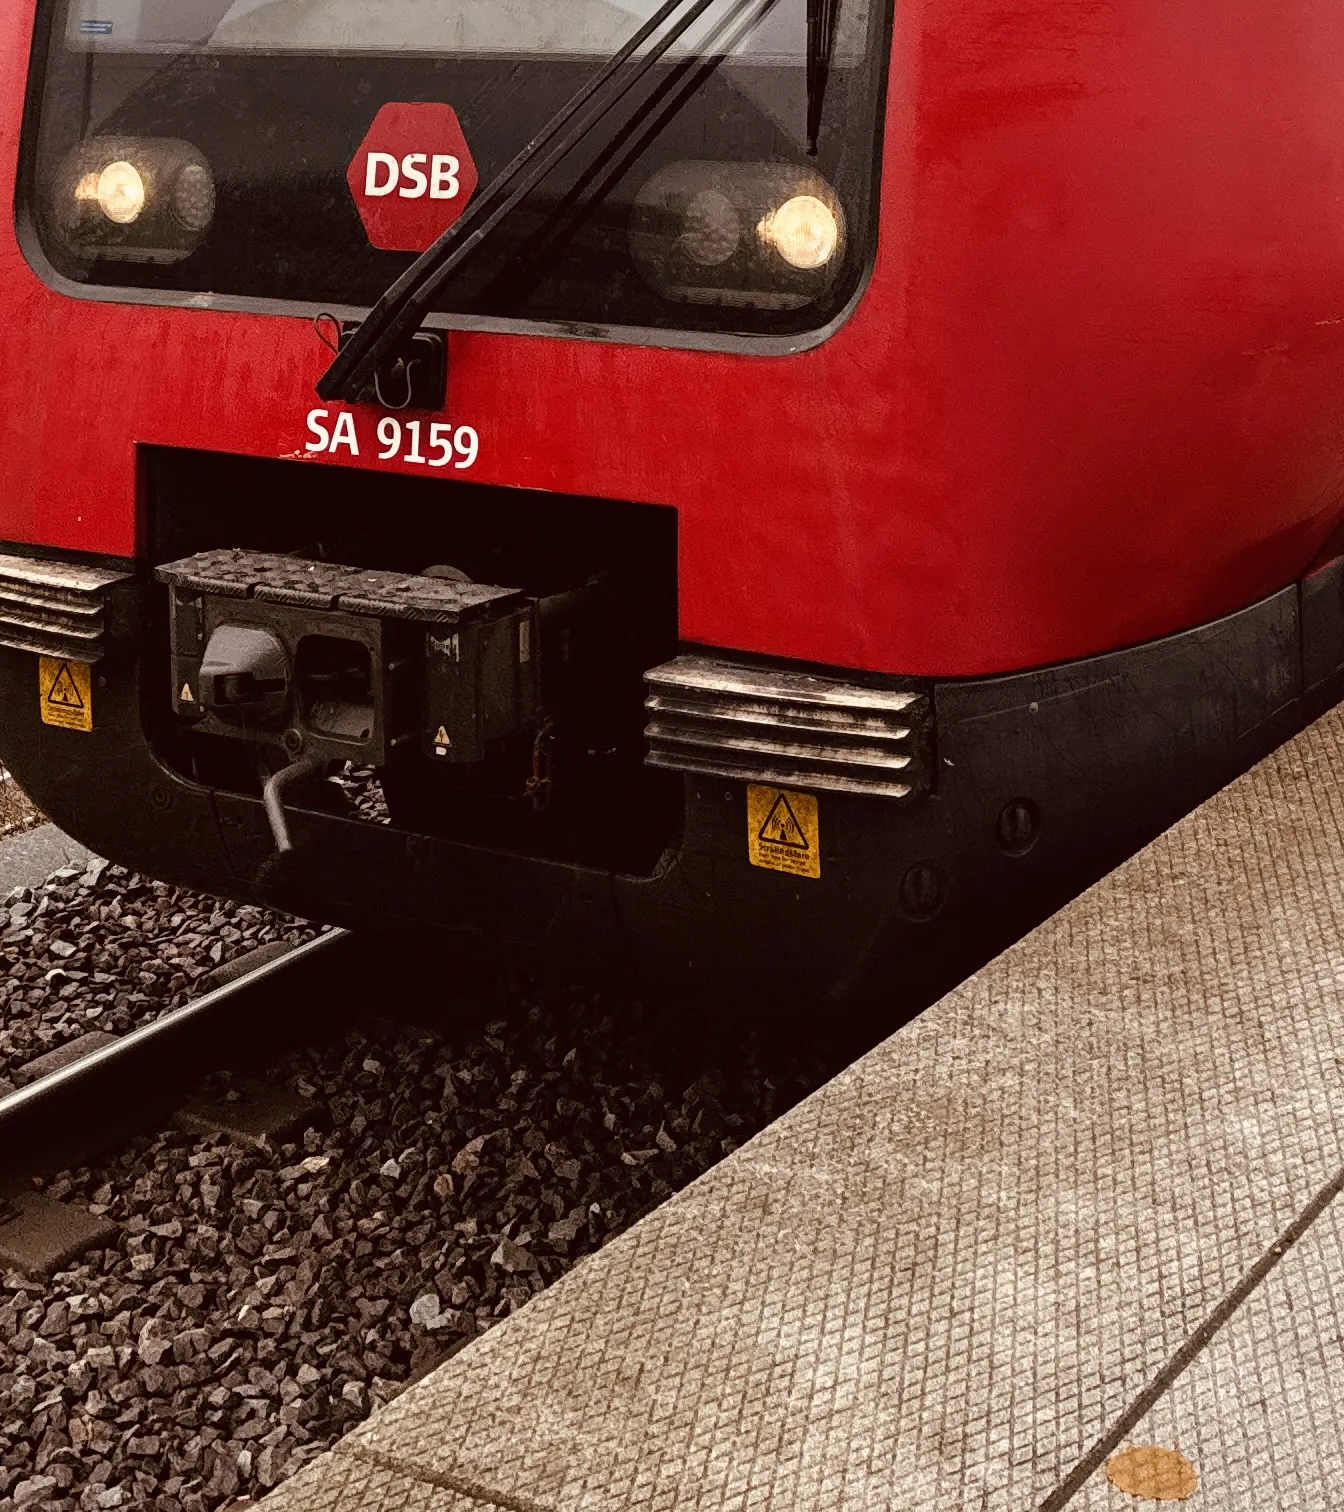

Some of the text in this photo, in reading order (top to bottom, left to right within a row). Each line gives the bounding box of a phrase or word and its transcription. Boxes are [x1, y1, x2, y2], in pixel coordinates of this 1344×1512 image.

[364, 152, 460, 200] DSB
[305, 409, 479, 469] SA 9159
